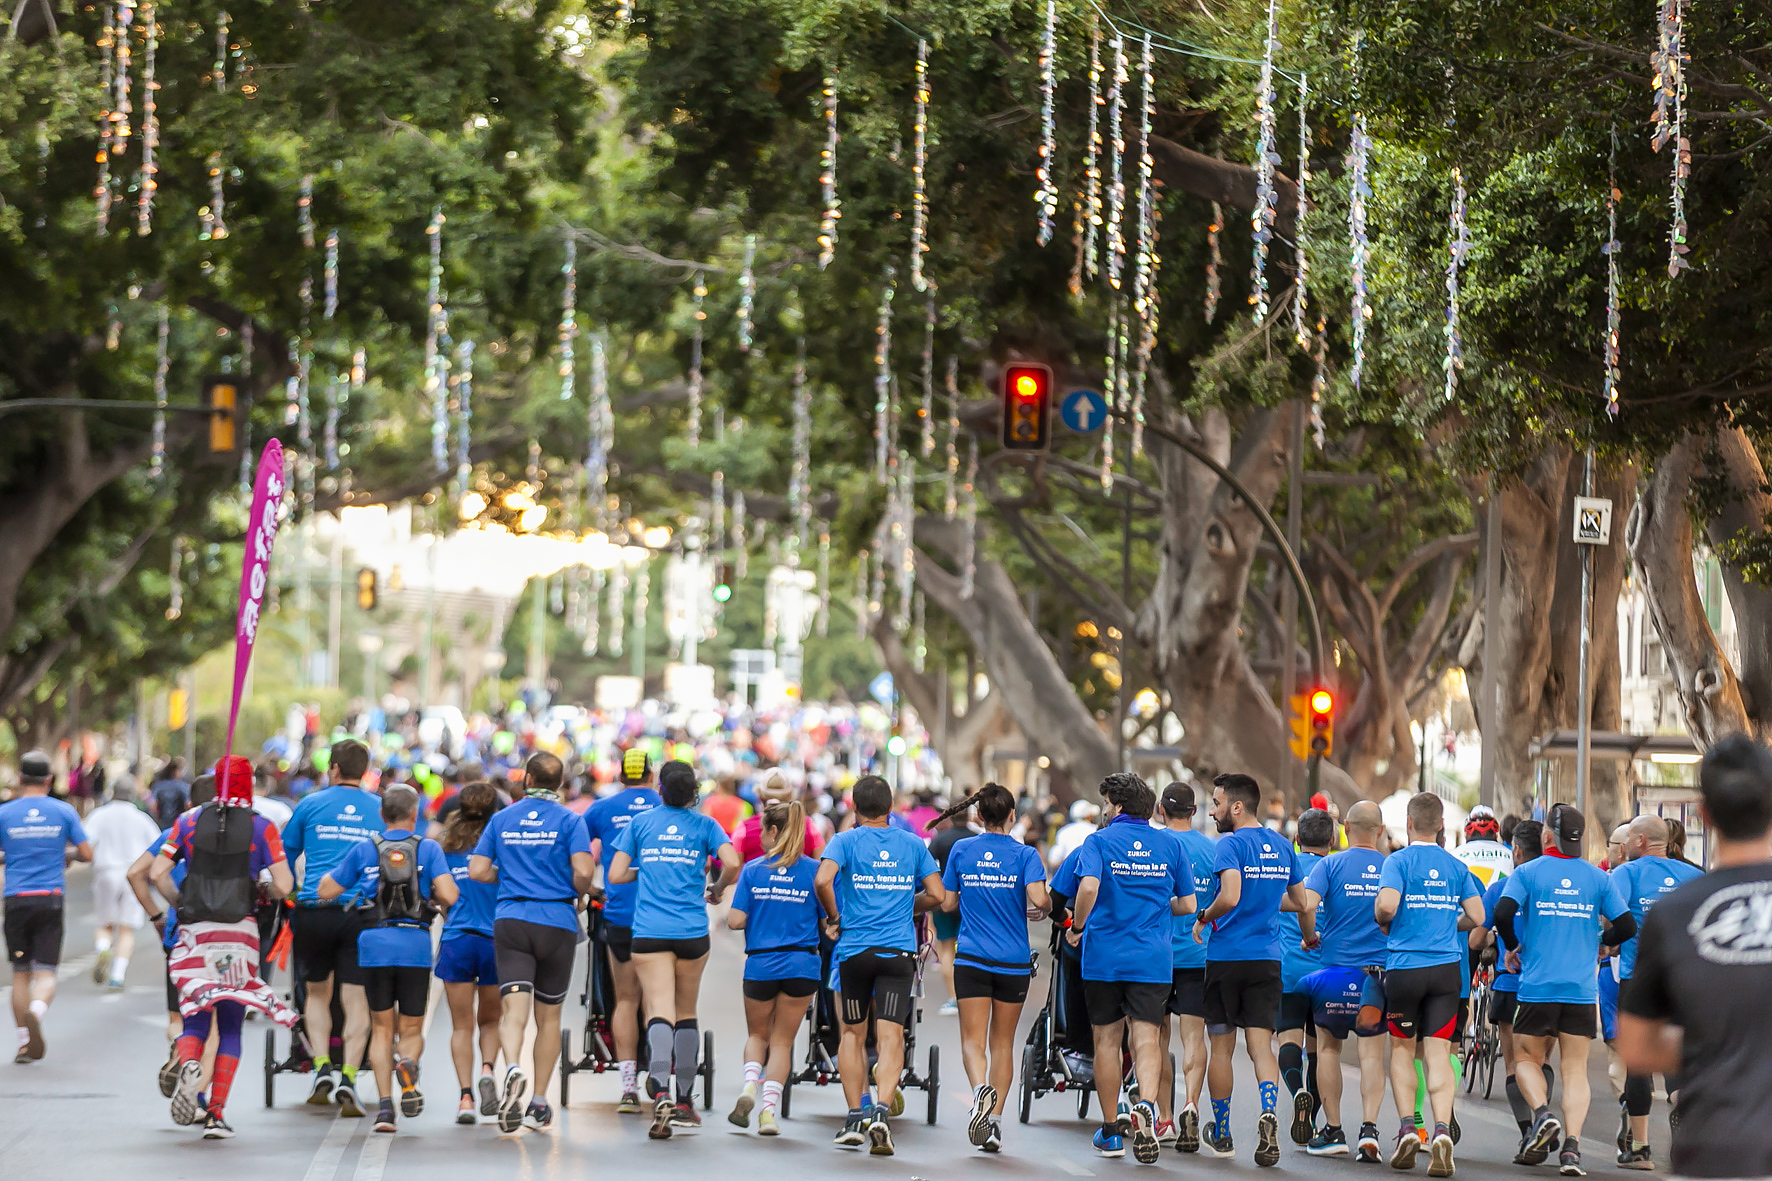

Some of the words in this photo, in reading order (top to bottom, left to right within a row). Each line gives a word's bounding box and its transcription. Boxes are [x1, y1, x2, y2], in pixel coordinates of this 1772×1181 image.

[689, 850, 700, 858] AT
[1473, 849, 1511, 860] vialia
[977, 861, 1000, 869] ZURICH
[852, 874, 876, 883] Corre,
[877, 875, 897, 883] frena
[898, 875, 905, 883] la
[1201, 878, 1211, 886] AT
[800, 890, 810, 898] AT
